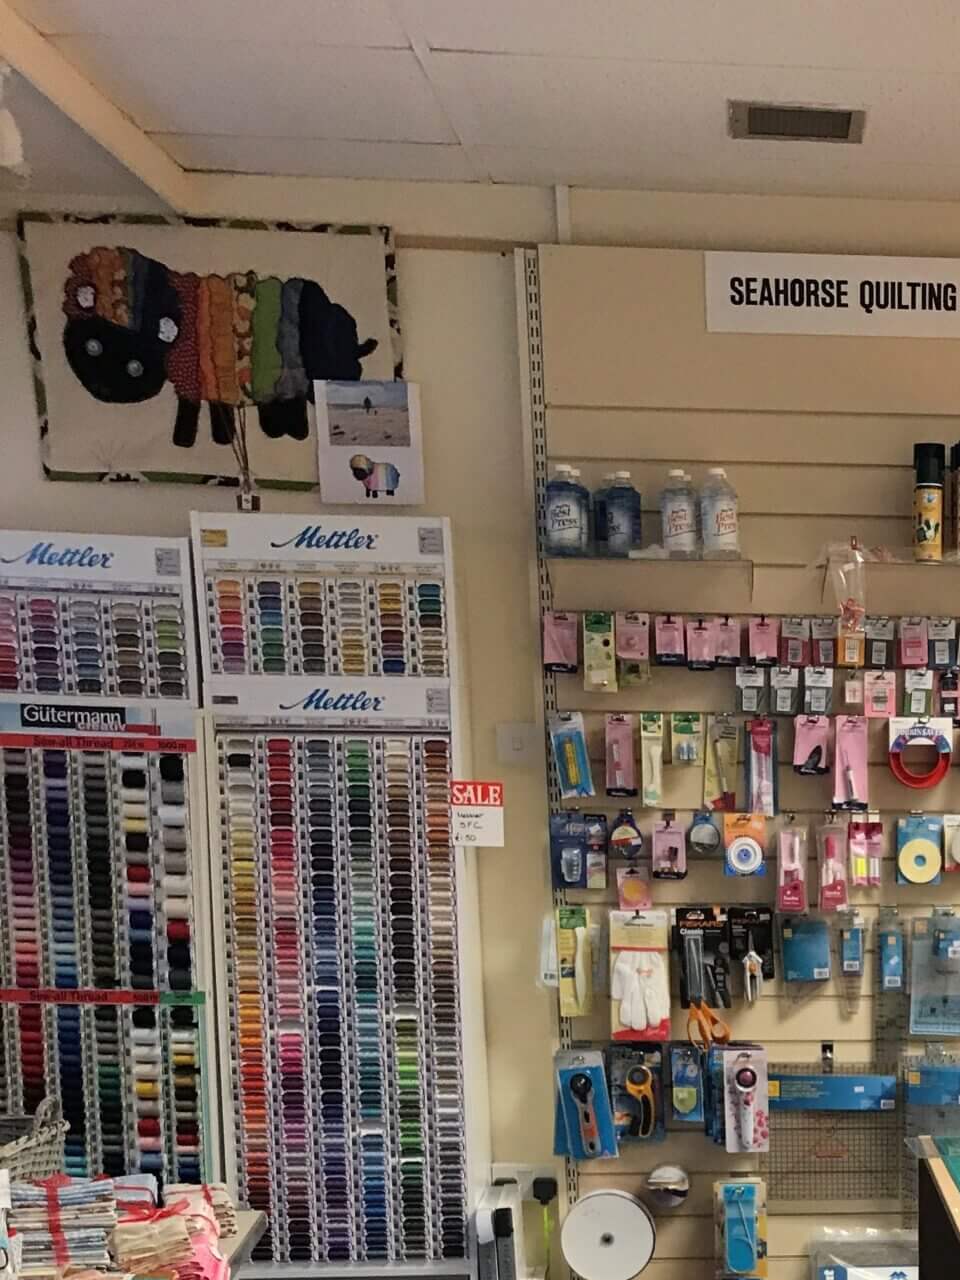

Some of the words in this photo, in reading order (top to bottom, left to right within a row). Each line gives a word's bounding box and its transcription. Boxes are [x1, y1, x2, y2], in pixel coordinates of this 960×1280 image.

[729, 277, 848, 308] SEAHORSE
[859, 280, 957, 314] QUILTING
[271, 526, 378, 549] Mettler
[0, 542, 114, 569] Mettler
[279, 688, 384, 712] Mettler
[23, 704, 122, 725] Gütermann
[452, 783, 501, 806] SALE
